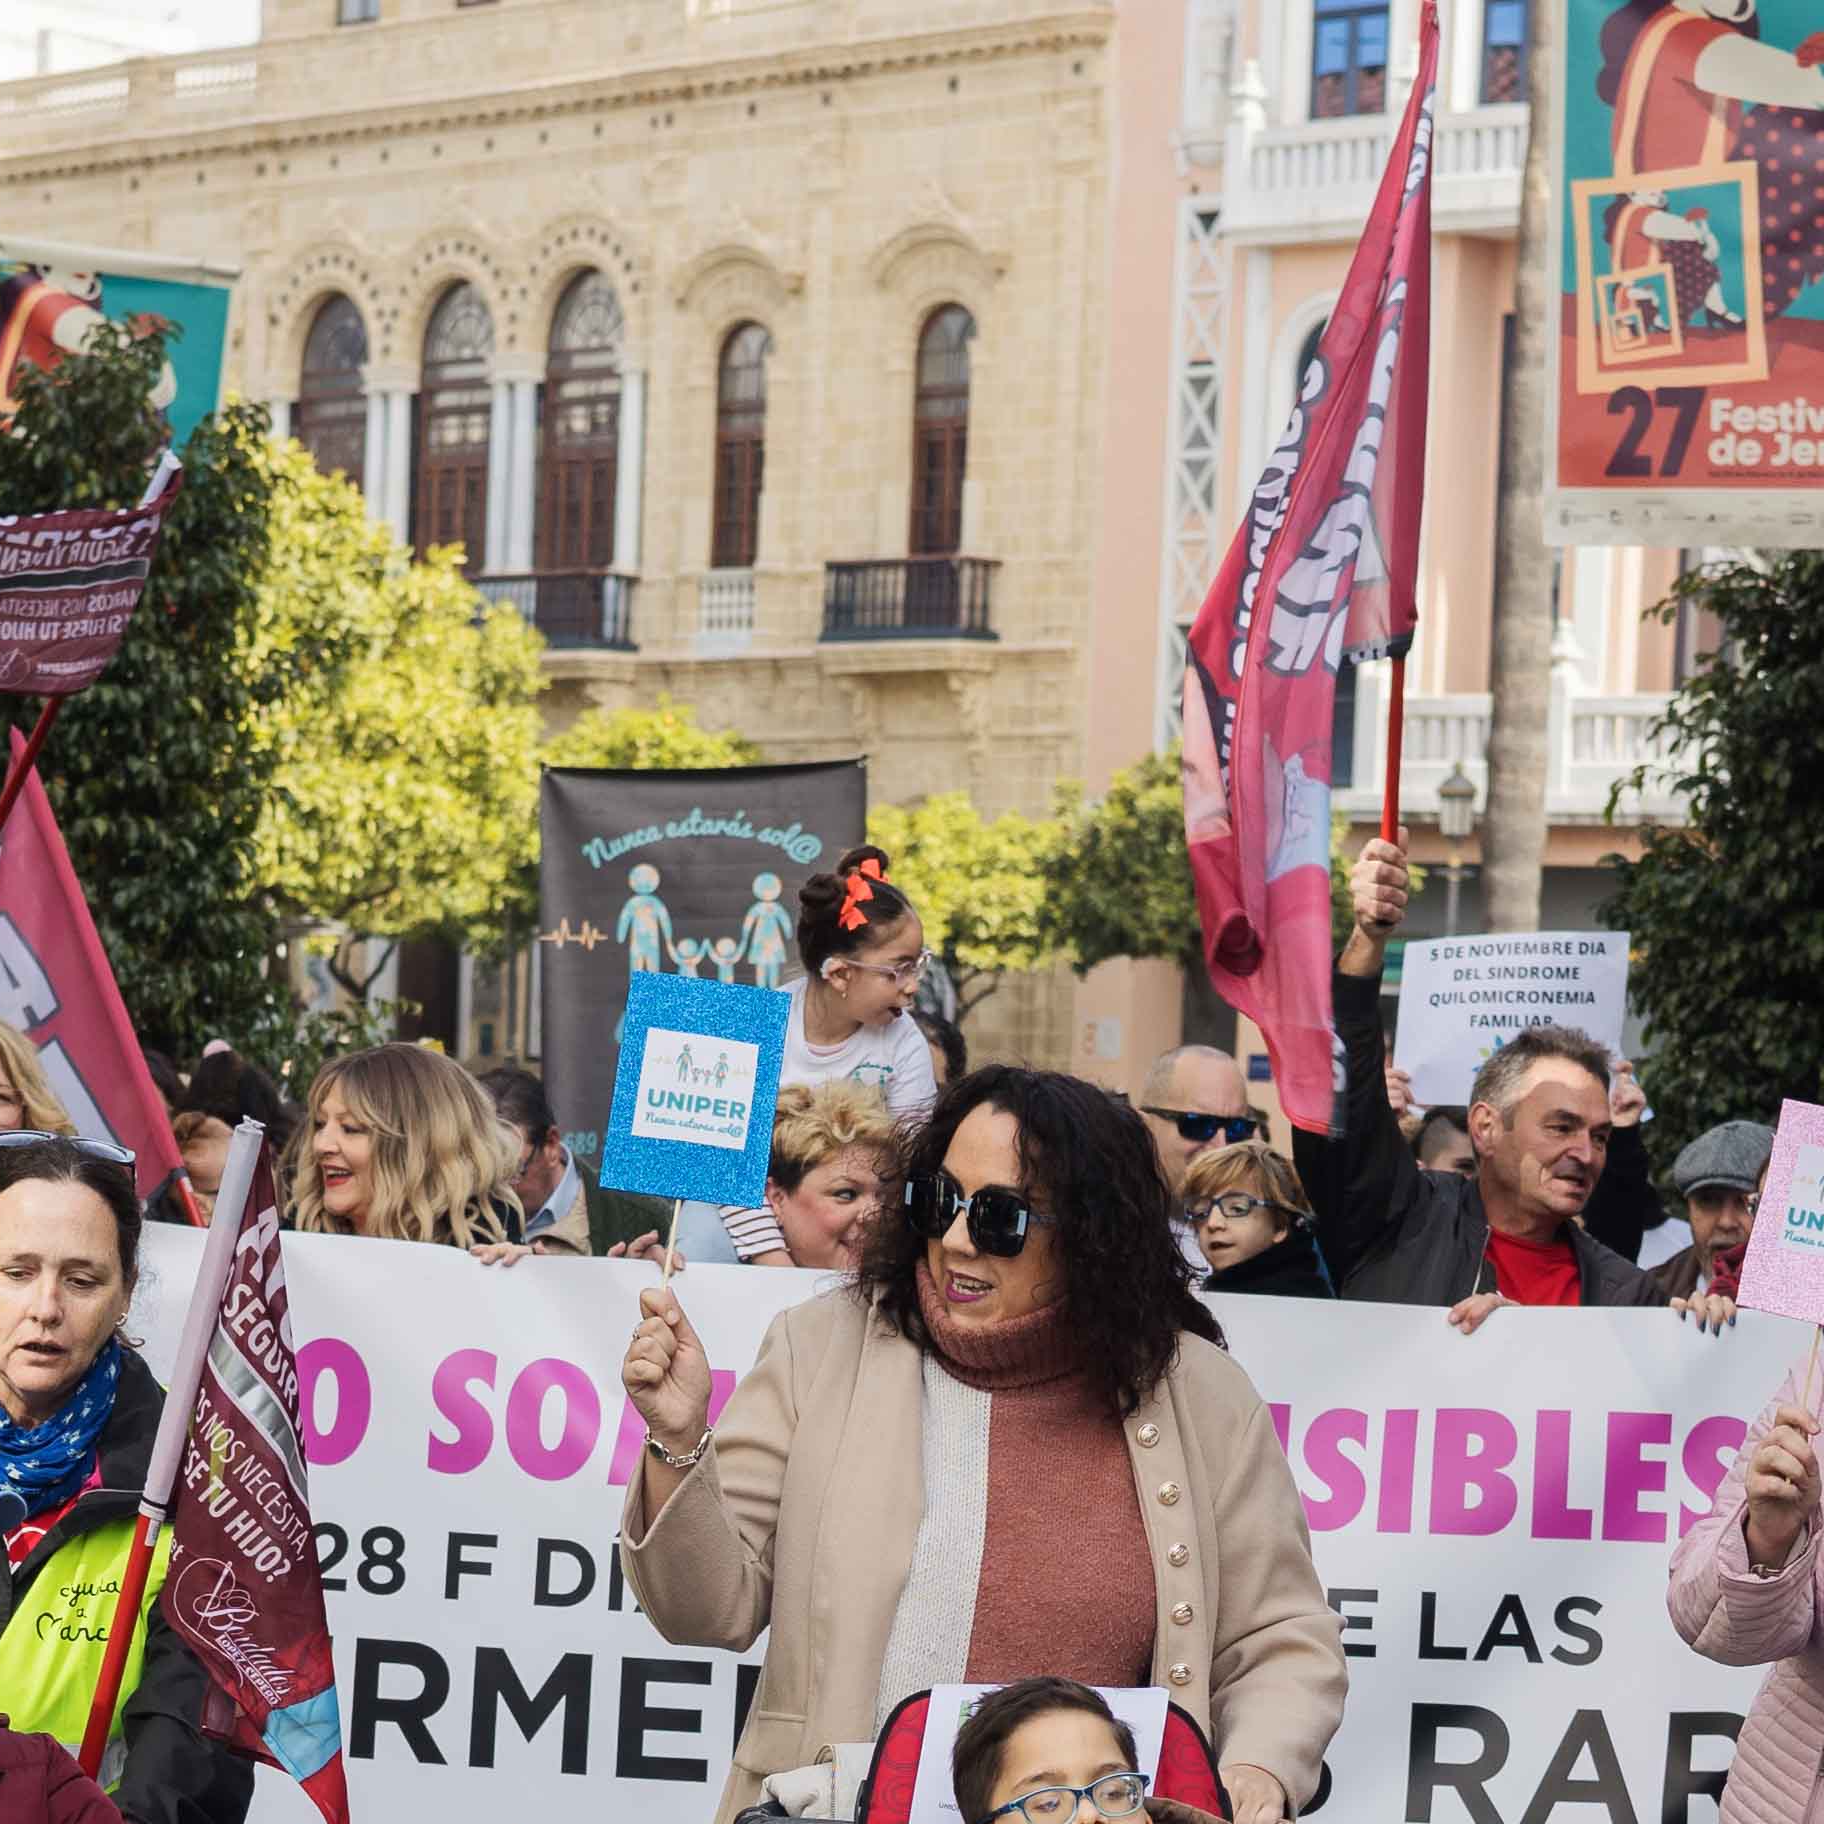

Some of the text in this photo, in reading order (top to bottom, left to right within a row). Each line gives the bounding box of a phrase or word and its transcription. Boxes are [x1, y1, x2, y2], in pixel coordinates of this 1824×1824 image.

[1604, 385, 1708, 478] 27
[1708, 433, 1768, 467] de
[583, 807, 823, 869] Nunca estarás sol@
[1430, 941, 1607, 962] 5 DE NOVIEMBRE DIA
[1453, 965, 1581, 981] DEL SINDROME
[1428, 990, 1596, 1007] QUILOMICRONEMIA
[1469, 1014, 1554, 1029] FAMILIAR
[647, 1087, 746, 1121] UNIPER
[222, 1283, 299, 1410] SEGUIR
[201, 1412, 311, 1562] NOS NECESITA,
[198, 1476, 291, 1584] TU HIJO?
[76, 1608, 87, 1618] a
[444, 1533, 499, 1601] F
[534, 1531, 643, 1613] DÍ
[1417, 1591, 1604, 1666] LAS
